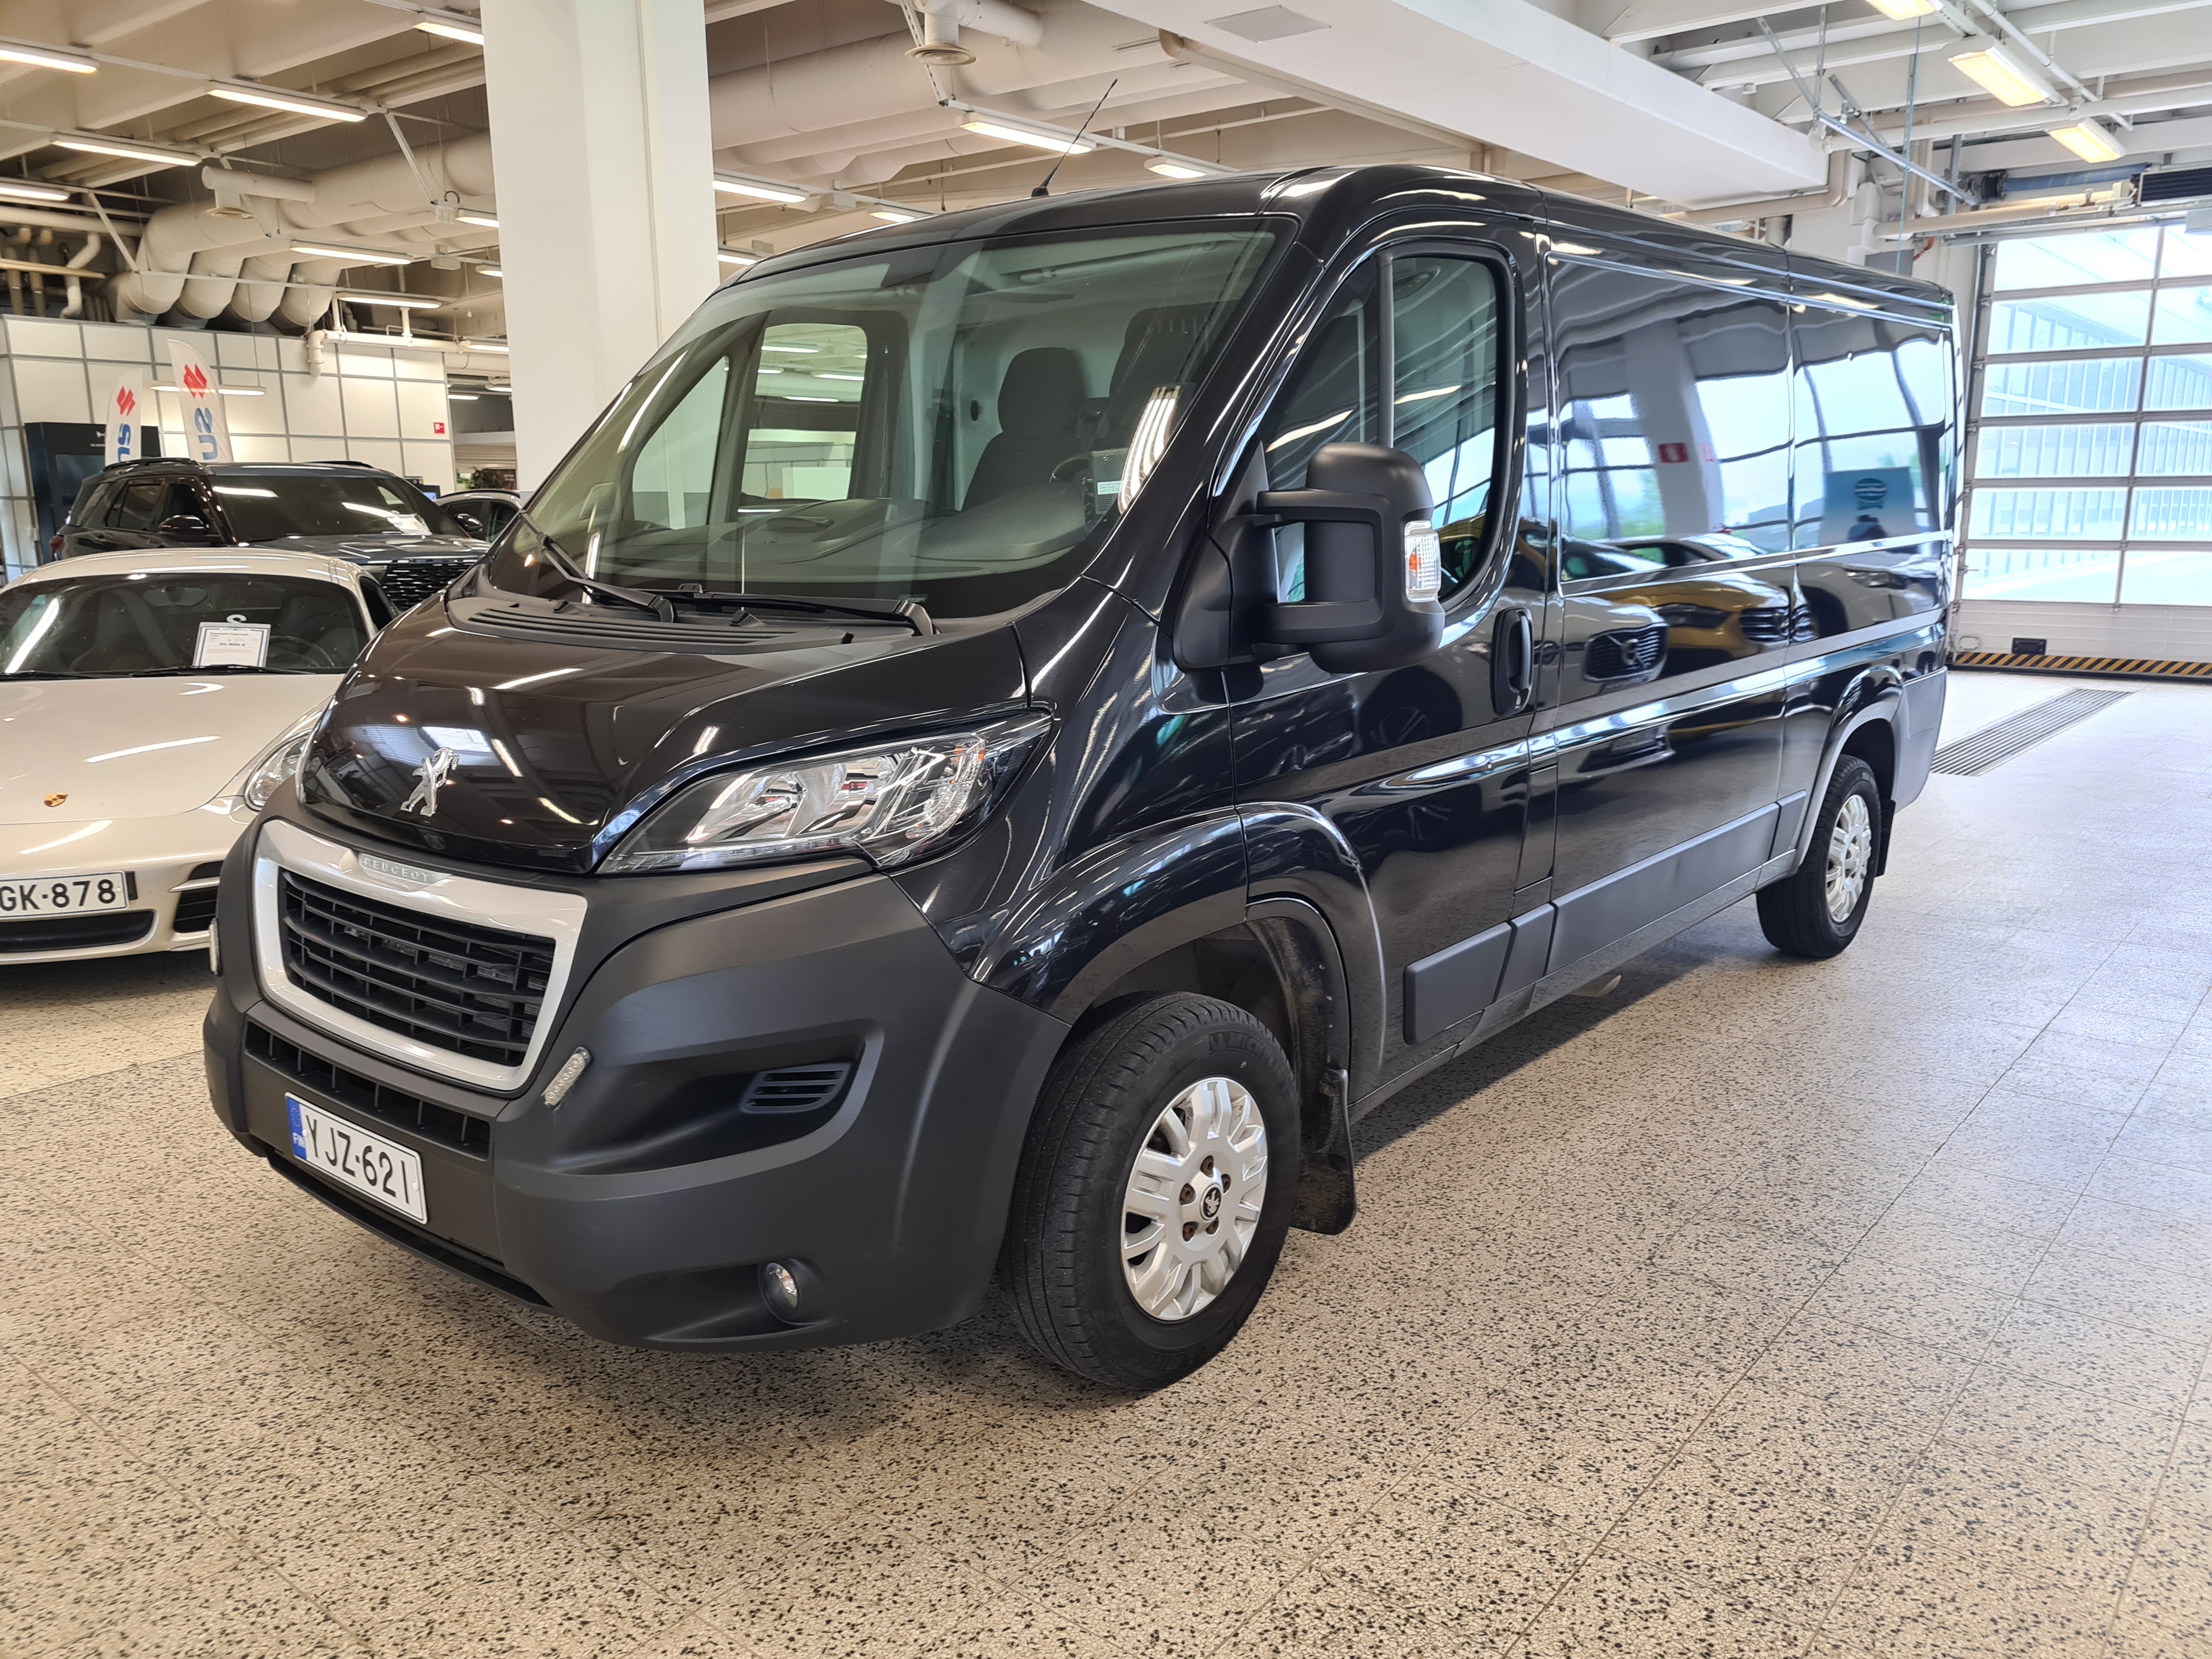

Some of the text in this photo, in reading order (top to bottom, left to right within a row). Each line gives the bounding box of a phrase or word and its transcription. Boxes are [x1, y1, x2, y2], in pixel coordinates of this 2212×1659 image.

[362, 857, 430, 882] PEUGEOT
[0, 879, 116, 911] GK-878
[306, 1114, 409, 1205] YJZ-621
